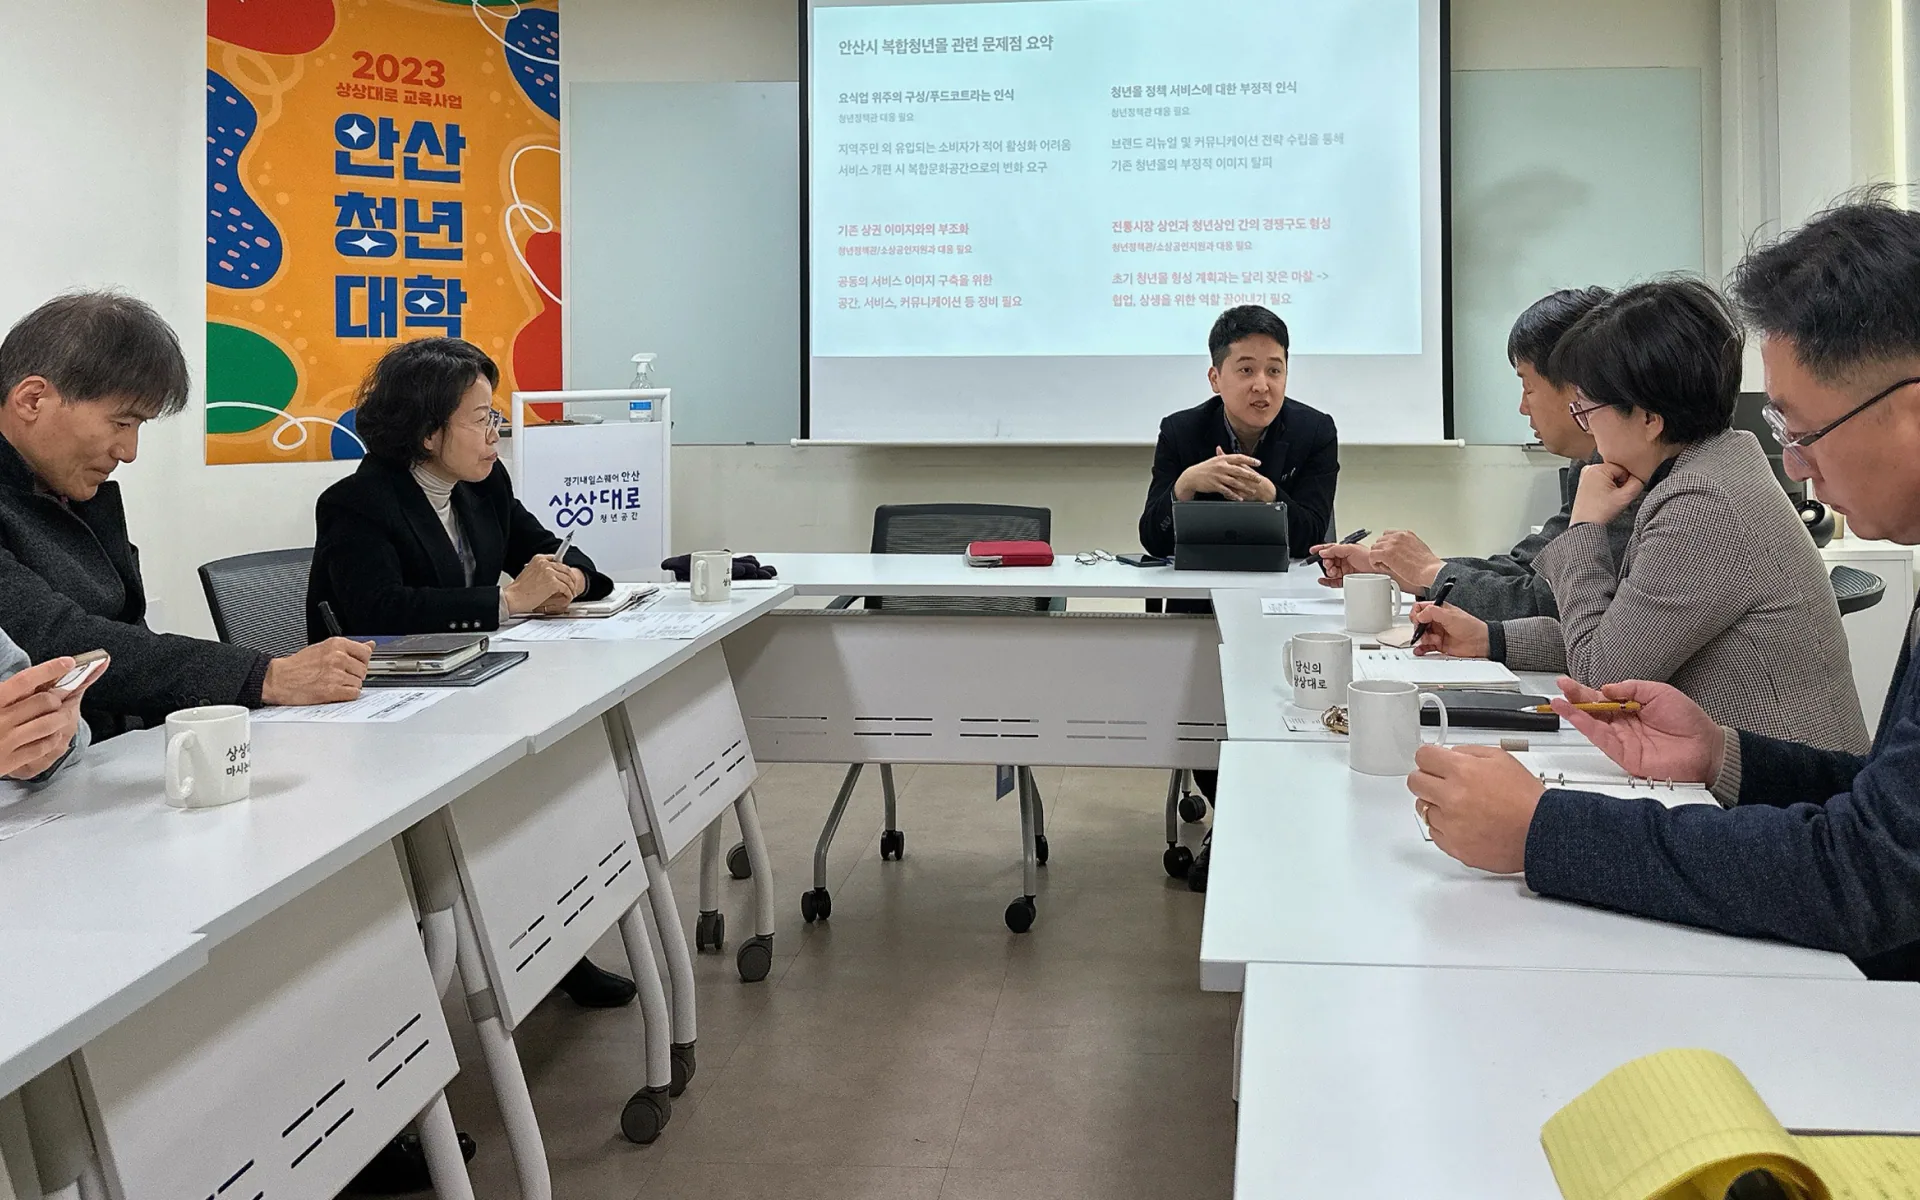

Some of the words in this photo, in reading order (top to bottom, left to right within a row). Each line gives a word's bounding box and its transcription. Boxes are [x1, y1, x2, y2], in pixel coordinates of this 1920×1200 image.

[839, 39, 878, 55] 안산시
[882, 38, 948, 55] 복합청년몰
[952, 37, 978, 53] 관련
[982, 36, 1022, 52] 문제점
[1026, 35, 1054, 51] 요약
[352, 51, 446, 88] 2023
[336, 82, 398, 102] 상상대로
[404, 90, 462, 109] 교육사업
[839, 92, 869, 104] 요식업
[872, 91, 902, 103] 위주의
[905, 90, 990, 103] 구성/푸드코트라는
[994, 89, 1014, 101] 인식
[1146, 85, 1167, 97] 정책
[1170, 84, 1212, 97] 서비스에
[1216, 83, 1236, 95] 대한
[1240, 82, 1272, 94] 부정적
[1276, 81, 1297, 94] 인식
[335, 113, 466, 183] 안산
[838, 143, 878, 155] 지역주민
[882, 143, 892, 155] 외
[895, 142, 936, 155] 유입되는
[939, 141, 979, 154] 소비자가
[982, 140, 1003, 152] 적어
[1111, 137, 1142, 150] 브랜드
[1146, 137, 1177, 149] 리뉴얼
[838, 165, 869, 177] 서비스
[896, 163, 905, 175] 시
[1027, 162, 1047, 173] 요구
[1111, 159, 1132, 172] 기존
[1181, 157, 1212, 170] 부정적
[1216, 157, 1248, 169] 이미지
[335, 191, 463, 261] 청년
[838, 224, 858, 237] 기존
[861, 224, 881, 236] 상권
[885, 224, 935, 236] 이미지와의
[939, 223, 969, 235] 부조화
[1112, 221, 1154, 233] 전통시장
[1157, 220, 1188, 232] 상인과
[1192, 219, 1235, 232] 청년상인
[1238, 218, 1260, 231] 간의
[838, 276, 868, 287] 공동의
[872, 275, 902, 287] 서비스
[905, 275, 935, 286] 이미지
[972, 274, 993, 286] 위한
[1112, 272, 1133, 284] 초기
[1242, 271, 1263, 283] 달리
[335, 274, 467, 338] 대학
[900, 296, 961, 308] 커뮤니케이션
[965, 296, 975, 308] 등
[1002, 296, 1022, 307] 필요
[1175, 294, 1195, 305] 위한
[564, 474, 619, 486] 경기내일스퀘어
[621, 471, 640, 482] 안산
[549, 487, 640, 527] 상상대로
[1296, 660, 1321, 674] 당신의
